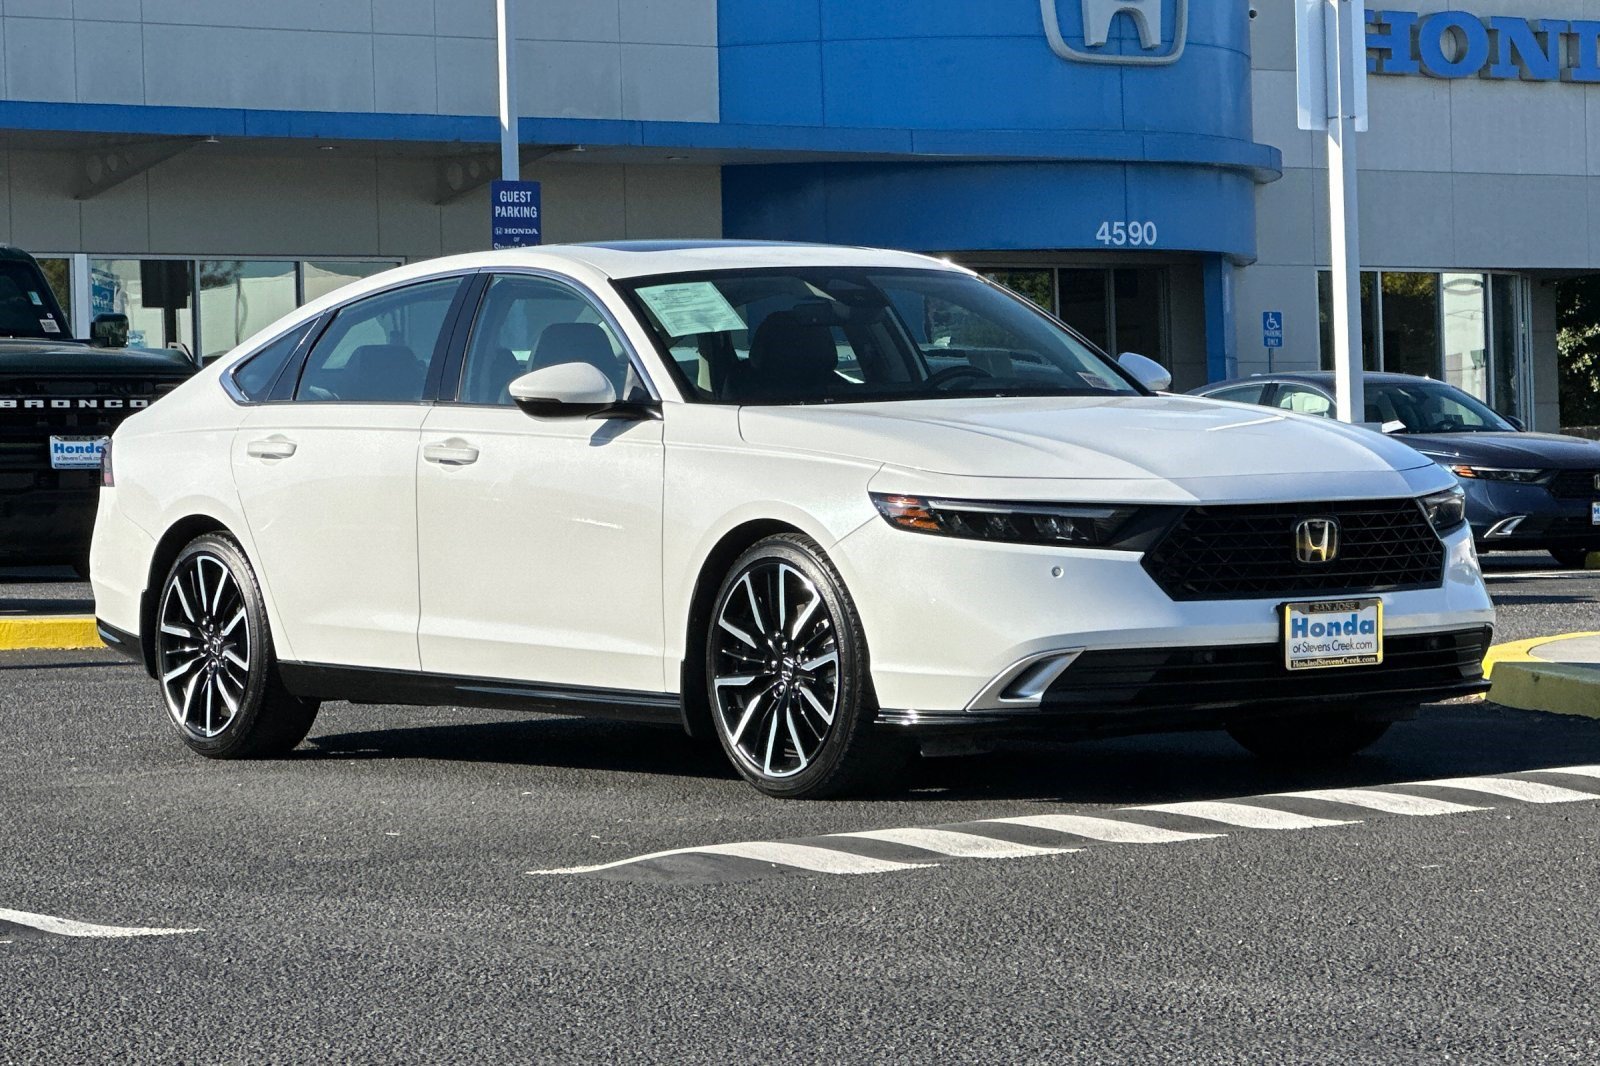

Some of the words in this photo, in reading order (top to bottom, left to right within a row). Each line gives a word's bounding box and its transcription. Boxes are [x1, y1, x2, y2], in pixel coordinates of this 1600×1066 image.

[500, 190, 532, 203] GUEST
[495, 206, 538, 218] PARKING
[1095, 221, 1158, 246] 4590
[0, 400, 149, 408] BRONCO
[1334, 602, 1356, 610] JOSE
[1291, 613, 1375, 638] Honda
[1293, 643, 1302, 653] of
[1302, 641, 1330, 653] Stevens
[1331, 638, 1373, 651] Creek.com
